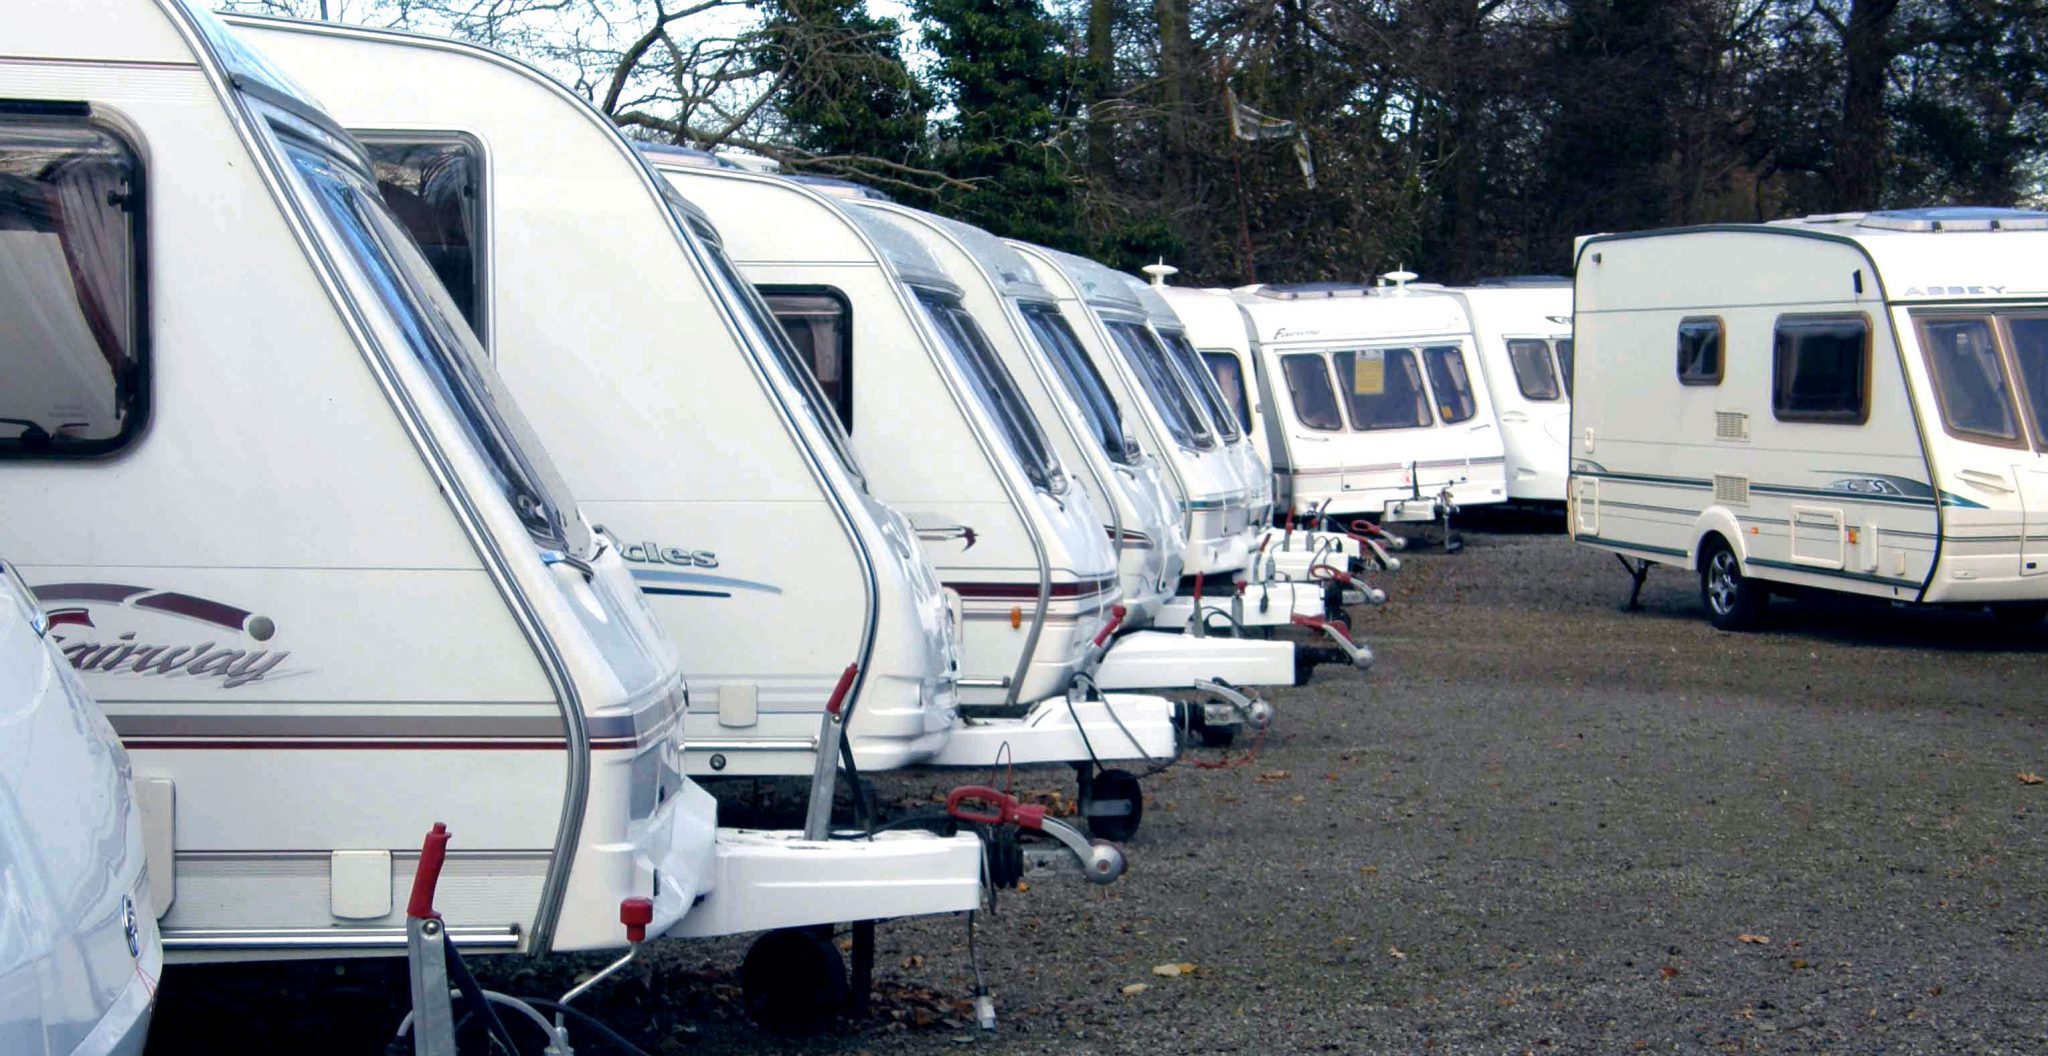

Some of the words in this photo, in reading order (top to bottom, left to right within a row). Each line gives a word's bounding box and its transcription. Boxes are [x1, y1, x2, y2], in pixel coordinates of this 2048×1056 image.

[1904, 286, 2006, 296] ABBEY
[619, 541, 719, 568] cles
[52, 632, 293, 689] airway
